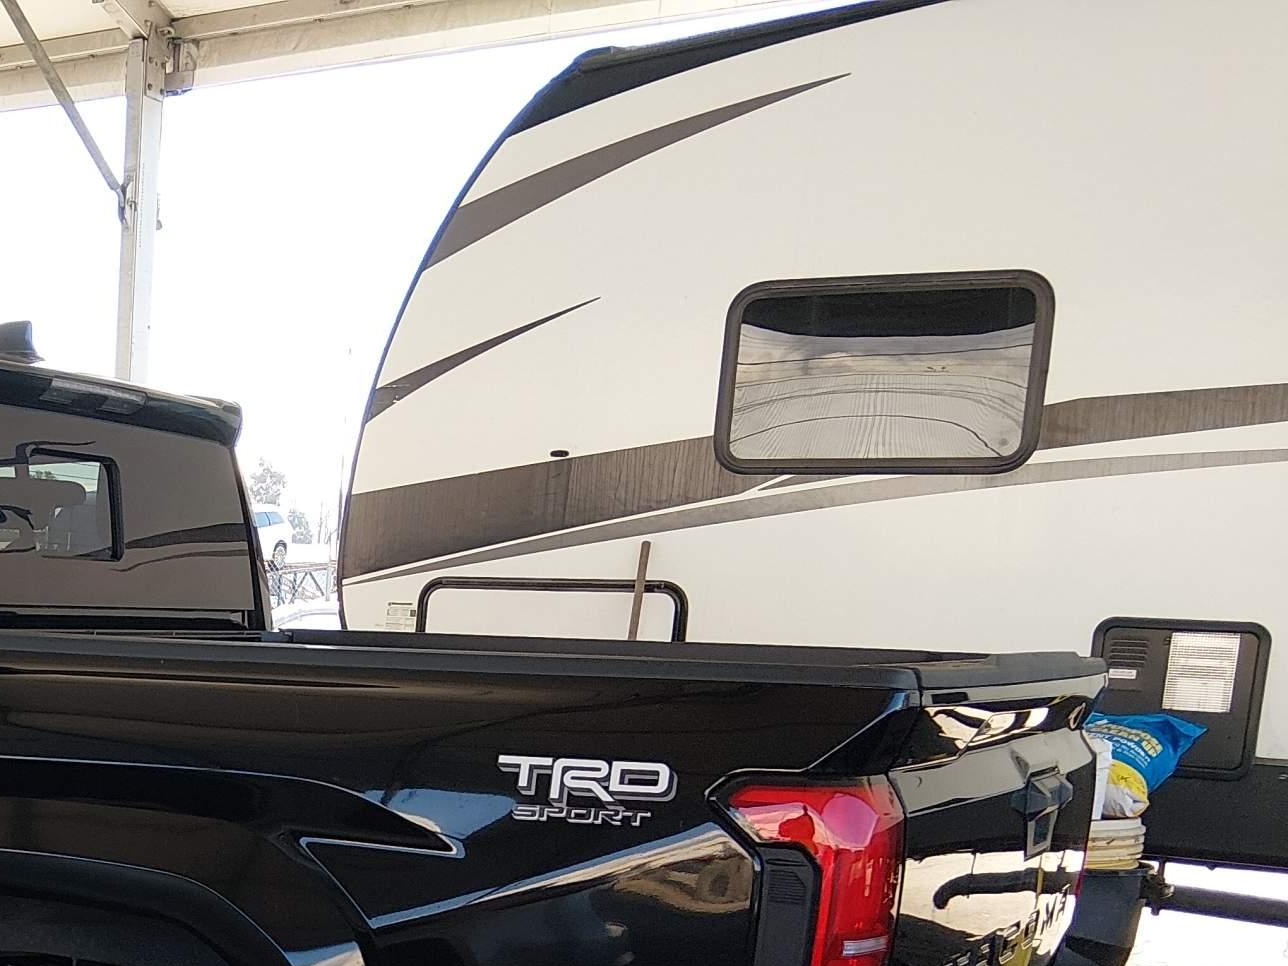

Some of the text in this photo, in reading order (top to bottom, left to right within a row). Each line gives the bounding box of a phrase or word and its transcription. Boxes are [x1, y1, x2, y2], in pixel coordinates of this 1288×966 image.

[1112, 737, 1151, 762] POWDER
[498, 754, 679, 810] TRD
[511, 802, 652, 827] SPORT
